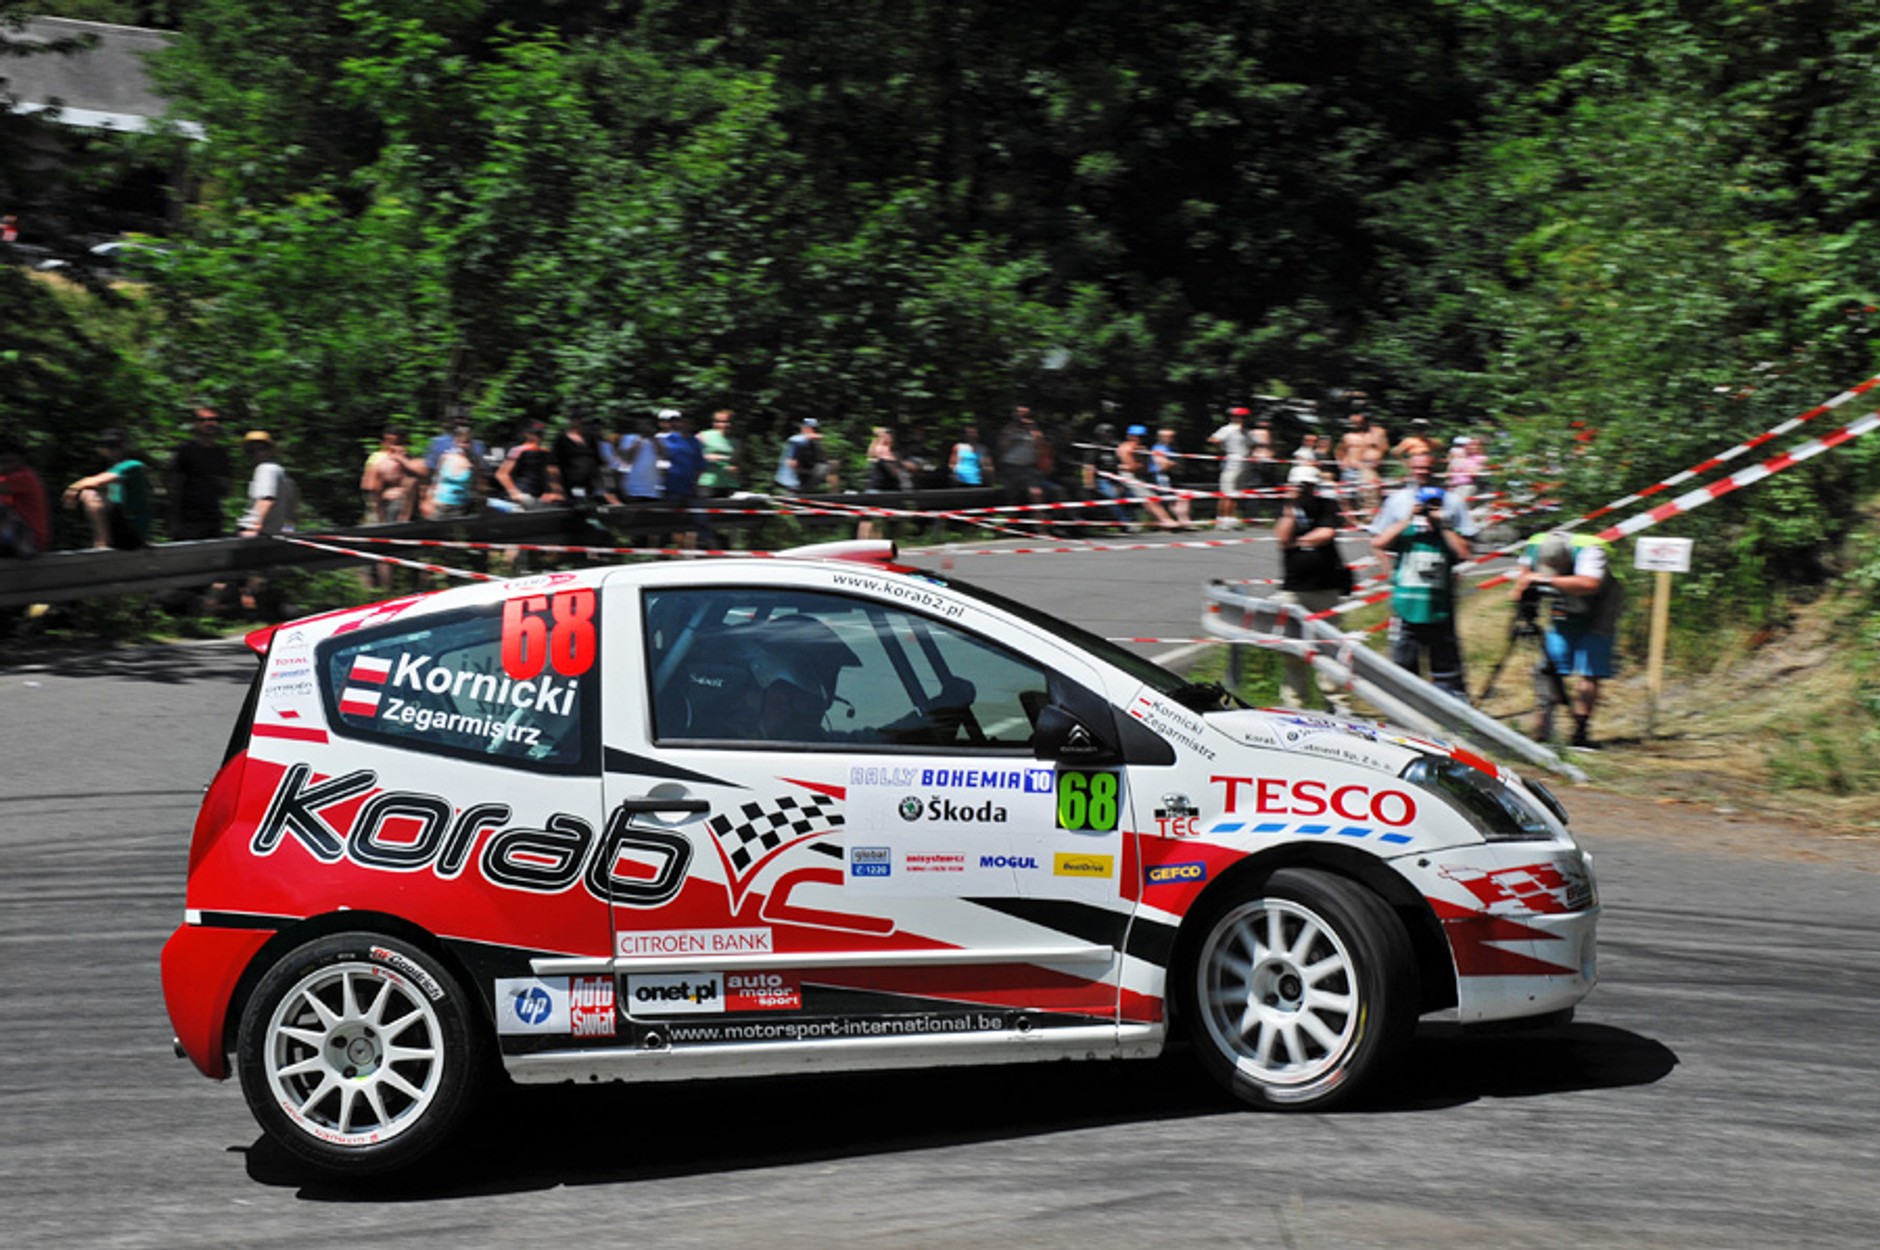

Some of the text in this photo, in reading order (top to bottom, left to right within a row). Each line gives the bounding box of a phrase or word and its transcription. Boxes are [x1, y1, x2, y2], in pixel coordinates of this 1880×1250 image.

[832, 573, 965, 618] www.korab2.pl
[500, 588, 596, 681] 68
[392, 652, 579, 716] Kornicki
[382, 698, 542, 747] Zegarmistrz
[1151, 701, 1204, 735] Kornicki
[1143, 712, 1217, 761] Zegarmistrz
[850, 767, 917, 786] RALLY
[921, 769, 1021, 789] BOHEMIA
[928, 795, 1008, 823] Škoda
[1060, 771, 1119, 830] 68
[1210, 775, 1417, 827] TESCO
[250, 763, 694, 907] Korab
[1155, 817, 1200, 838] TEC
[853, 850, 888, 862] global
[980, 855, 1039, 869] MOGUL
[1149, 865, 1202, 881] GEFCO
[713, 933, 768, 951] BANK
[570, 978, 613, 1007] Auto
[635, 981, 717, 1005] onet.pl
[728, 975, 783, 988] auto
[739, 988, 793, 997] motor
[520, 988, 547, 1024] hp
[669, 1015, 1003, 1041] www.motorsport-international.be
